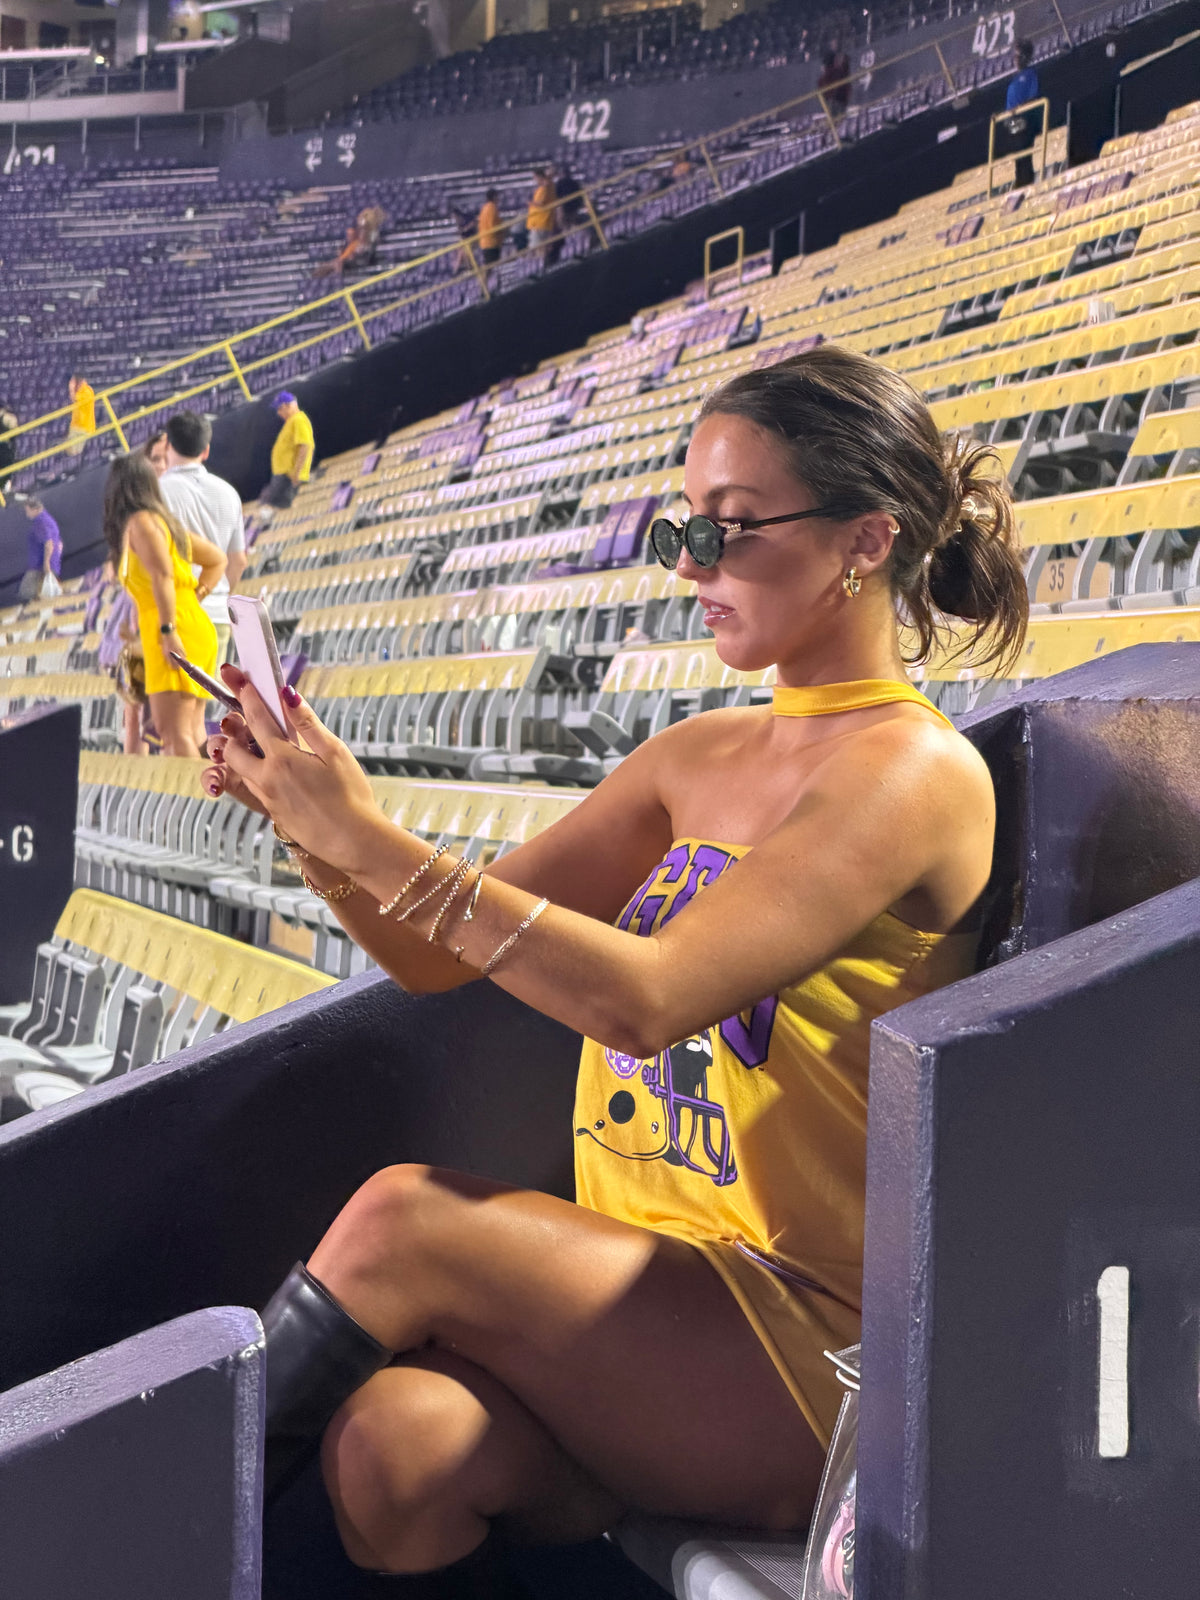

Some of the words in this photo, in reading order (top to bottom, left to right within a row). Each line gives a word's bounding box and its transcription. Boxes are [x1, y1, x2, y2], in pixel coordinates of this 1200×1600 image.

[972, 10, 1015, 58] 423
[560, 99, 611, 143] 422
[1049, 562, 1065, 591] 35
